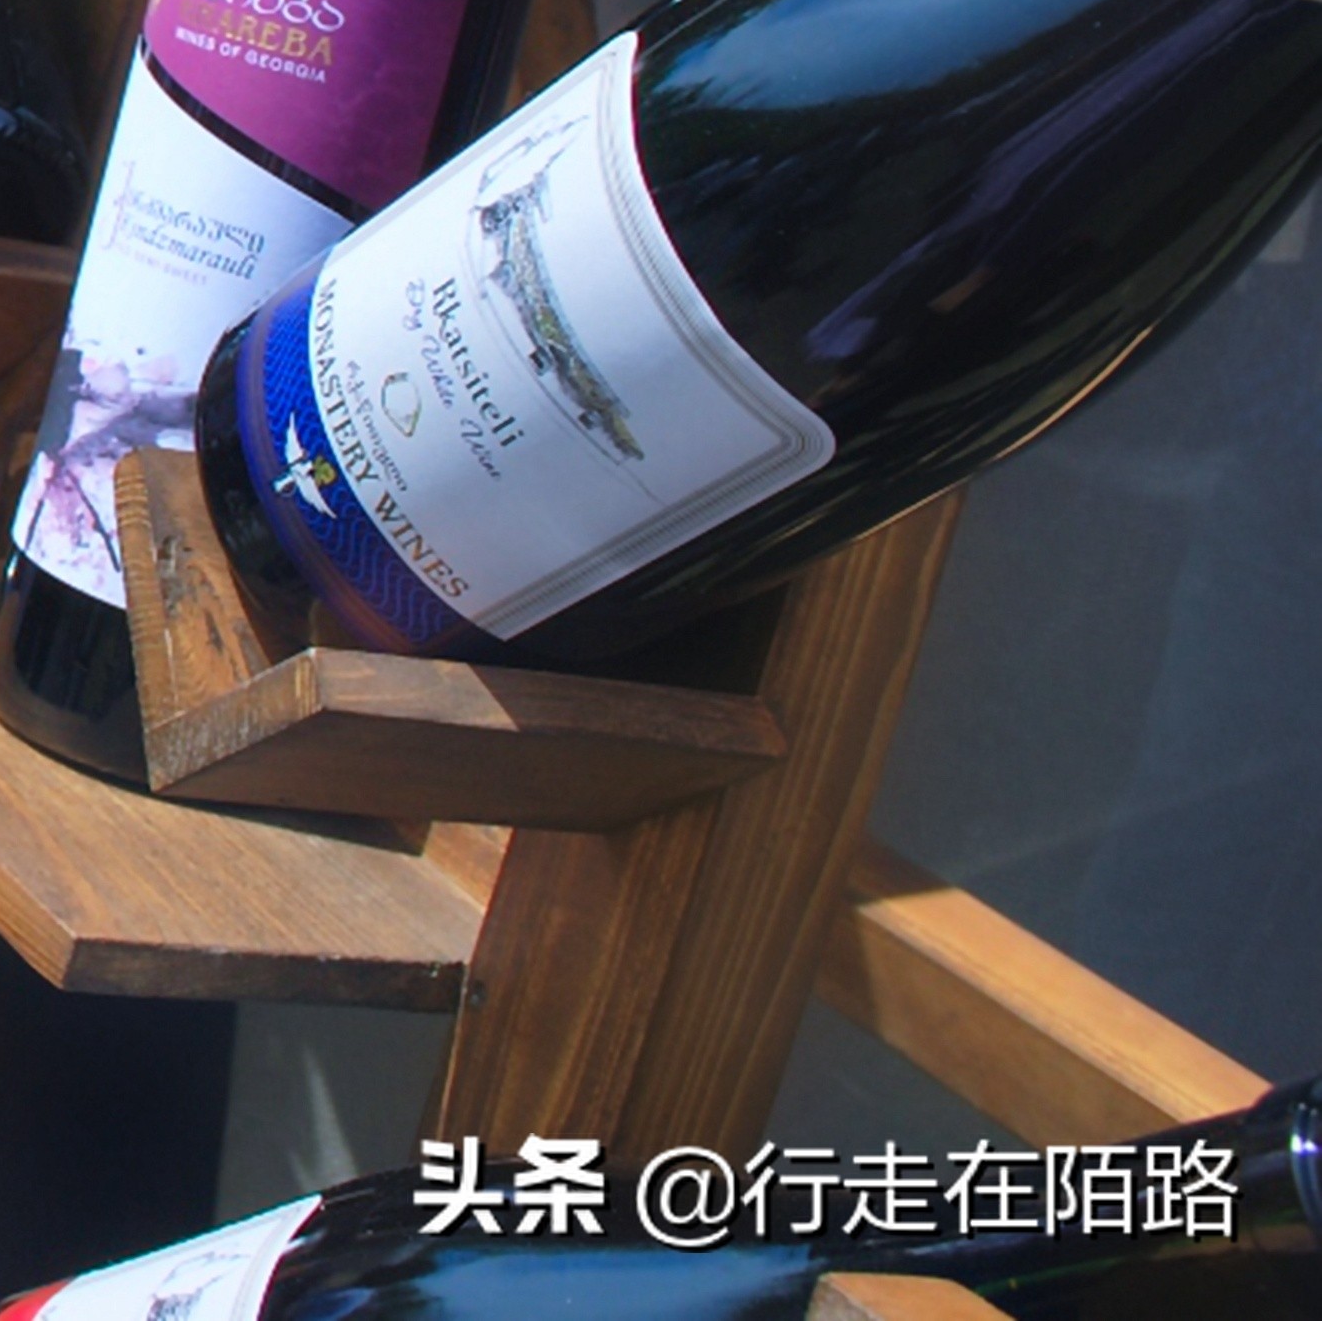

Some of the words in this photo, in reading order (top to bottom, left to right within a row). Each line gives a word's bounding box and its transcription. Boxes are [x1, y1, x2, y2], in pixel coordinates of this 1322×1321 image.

[218, 41, 242, 58] OF
[244, 48, 327, 84] GEORGIA
[432, 277, 525, 447] Rkatsiteli
[314, 278, 381, 484] MONASTERY
[373, 489, 470, 599] WINES
[460, 417, 502, 483] Wine
